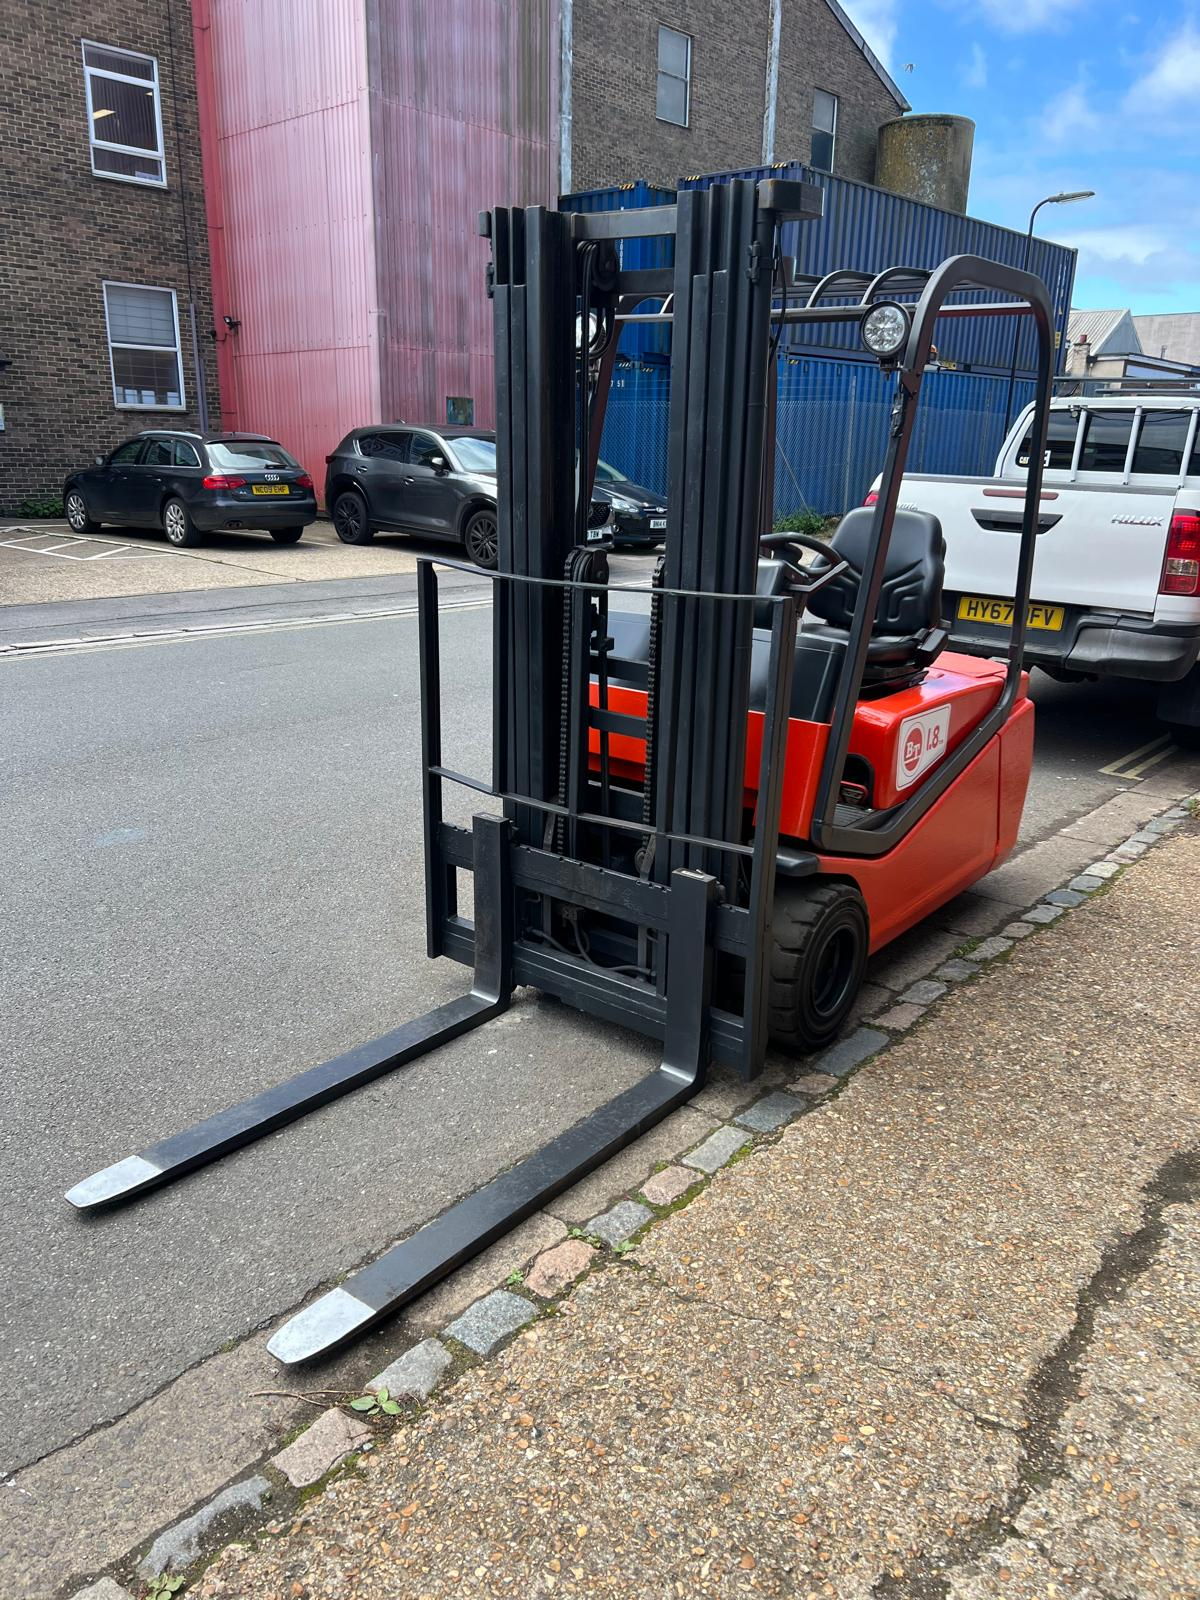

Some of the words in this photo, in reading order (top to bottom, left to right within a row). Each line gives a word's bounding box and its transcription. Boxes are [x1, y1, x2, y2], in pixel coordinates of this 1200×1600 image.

[1111, 514, 1164, 526] HILUX
[966, 600, 1014, 620] HY67
[1029, 607, 1055, 625] FV
[905, 741, 921, 760] BT
[927, 725, 939, 751] 1.8
